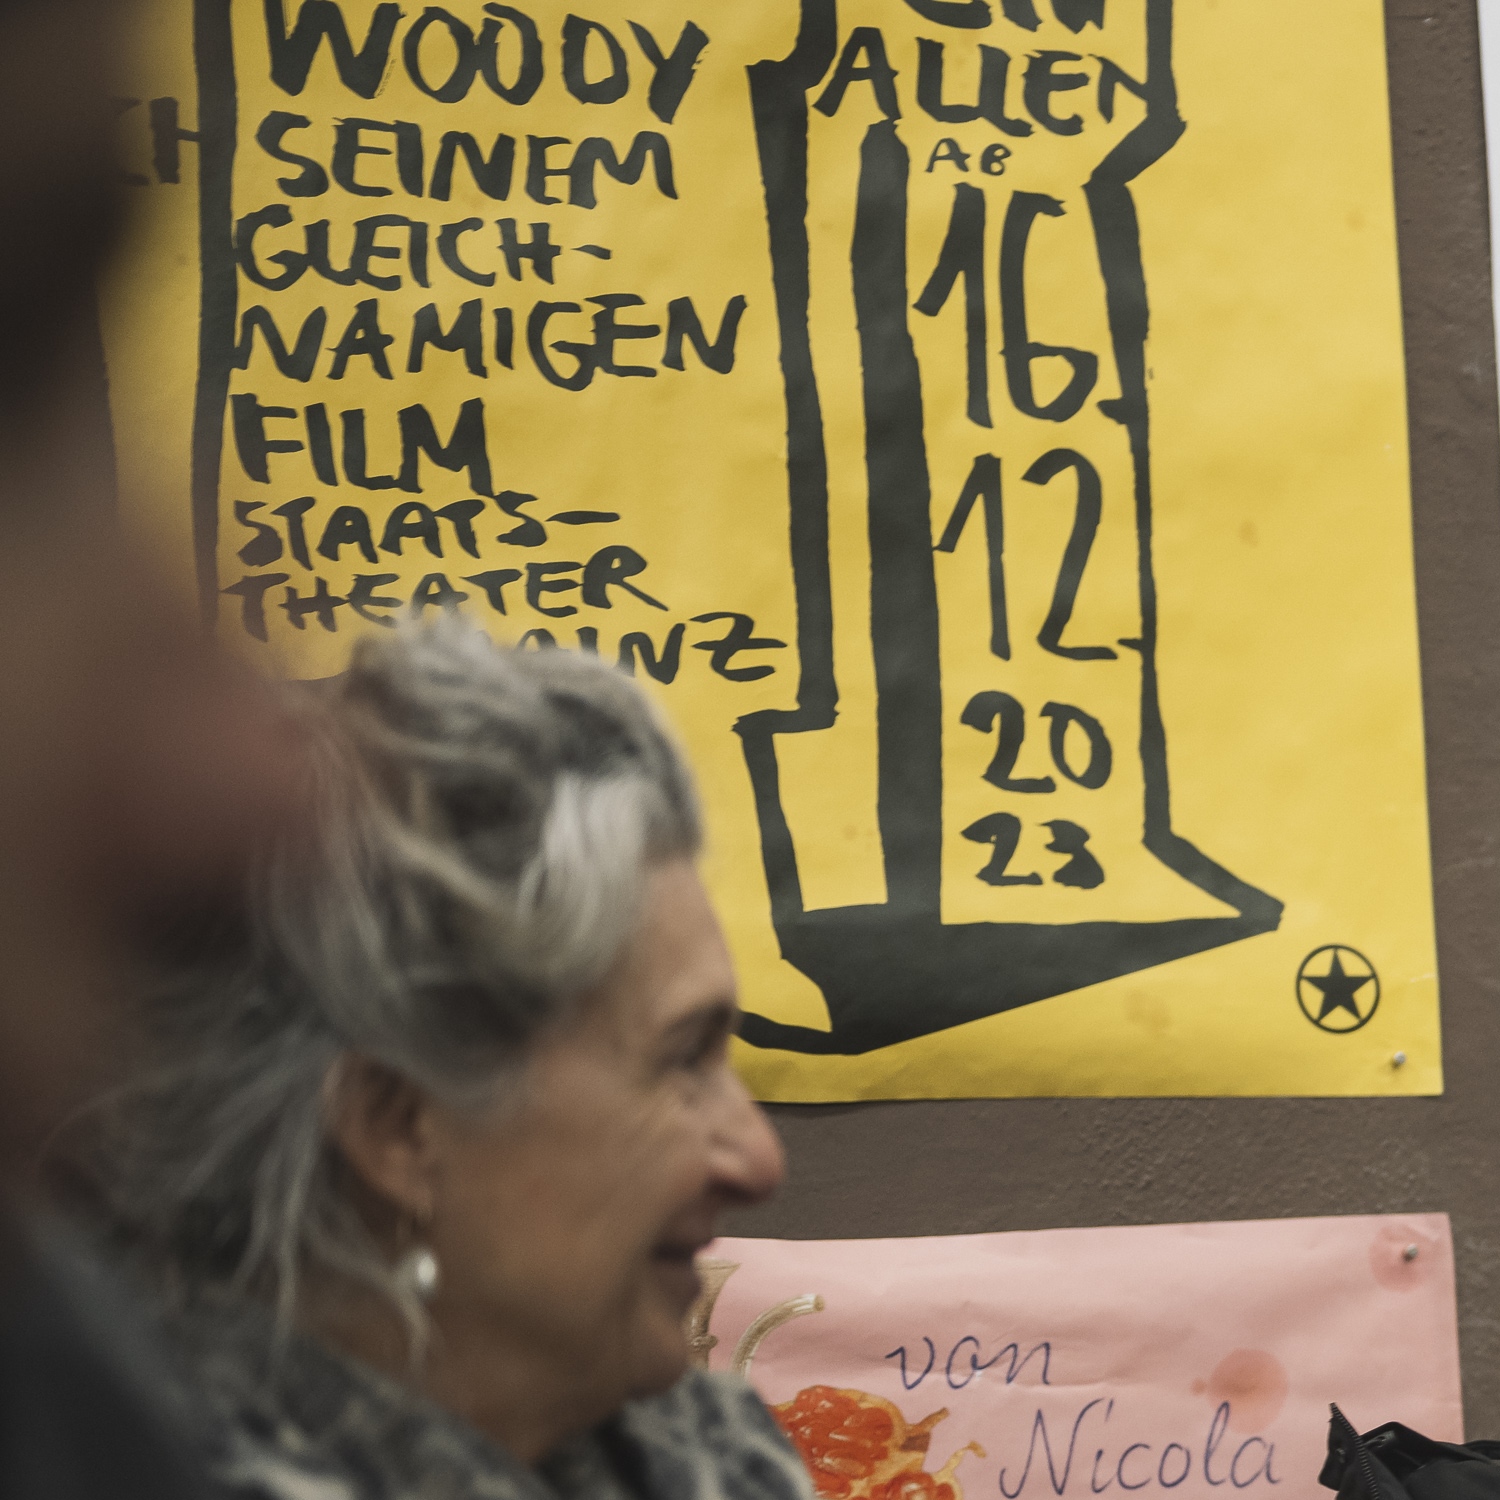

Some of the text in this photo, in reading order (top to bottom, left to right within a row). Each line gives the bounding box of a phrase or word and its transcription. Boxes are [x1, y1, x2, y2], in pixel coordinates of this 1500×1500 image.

[262, 0, 709, 124] WOODY
[812, 26, 1168, 137] ALLEN
[254, 110, 678, 210] SEINEM
[925, 138, 1012, 176] AB
[236, 203, 613, 291] GLEICH-
[233, 293, 747, 392] NAMIGEN
[912, 182, 1099, 429] 16
[229, 396, 494, 498] FILM
[233, 490, 620, 571] STAATS-
[932, 447, 1118, 661] 12
[220, 544, 670, 643] THEATER
[959, 690, 1113, 793] 20
[959, 811, 1105, 890] 23
[885, 1335, 1053, 1390] von
[999, 1397, 1281, 1500] Nicola
